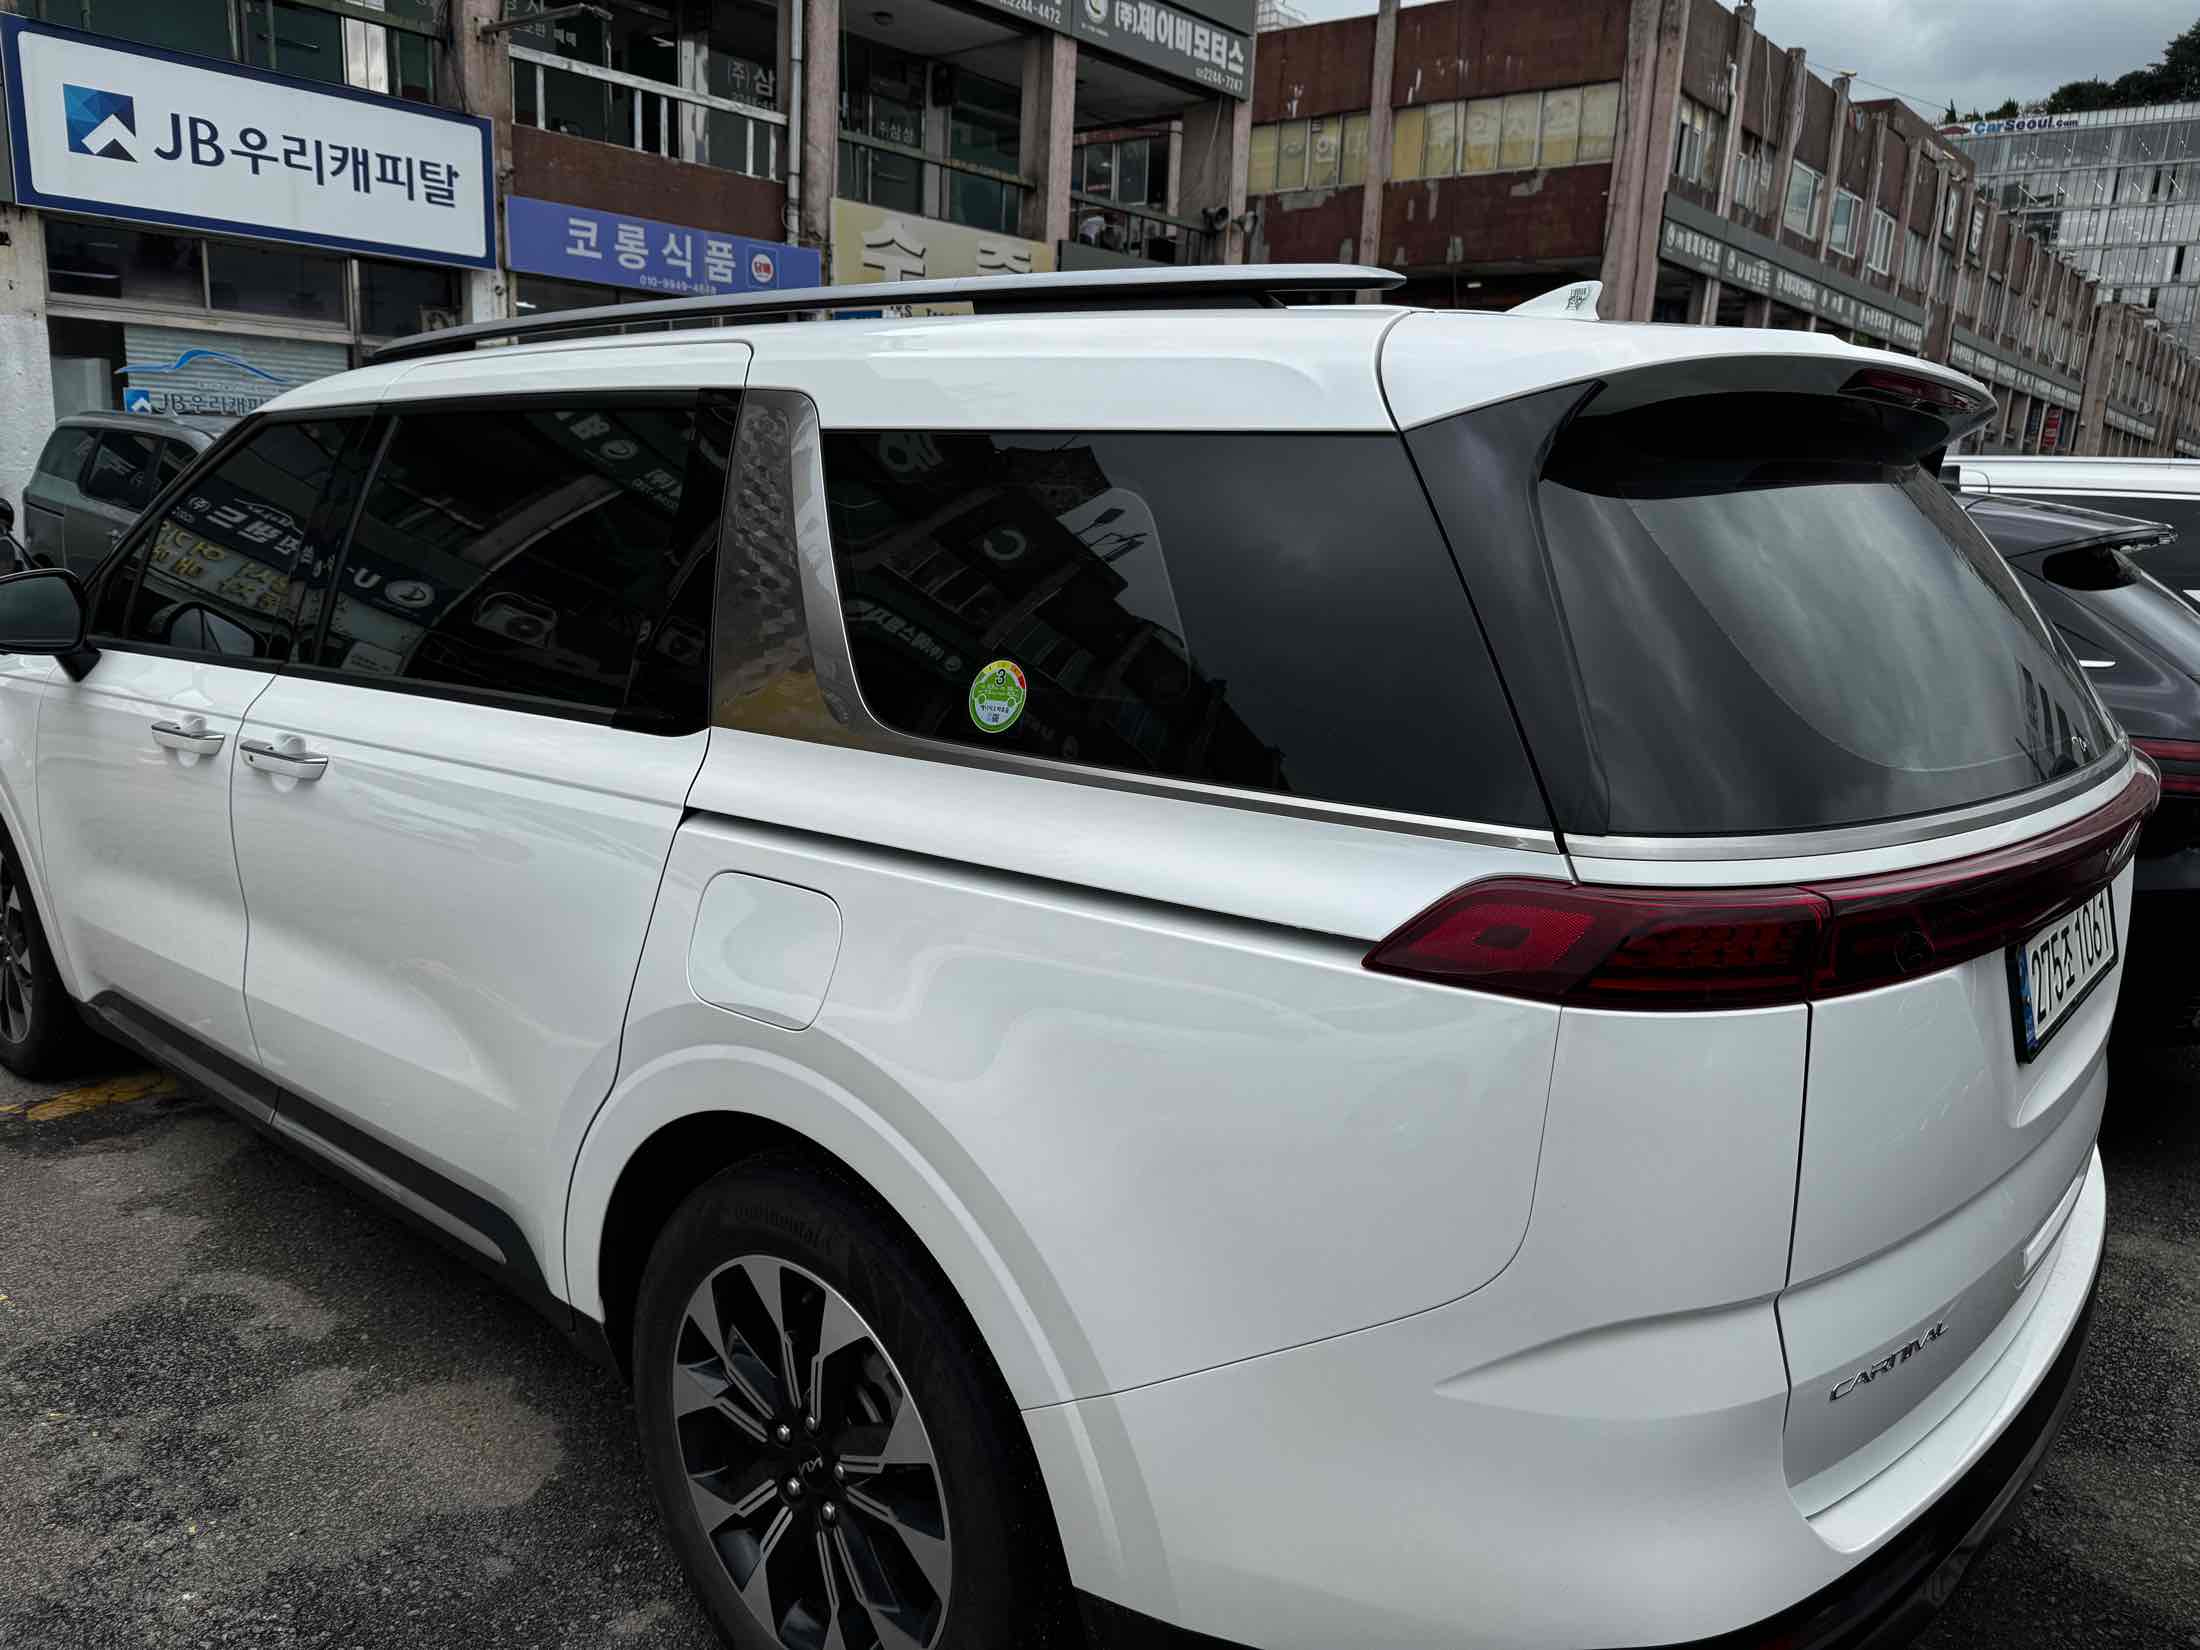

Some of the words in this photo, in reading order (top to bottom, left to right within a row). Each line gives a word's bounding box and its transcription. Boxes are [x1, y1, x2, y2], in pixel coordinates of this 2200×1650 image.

[1115, 1, 1245, 75] (주)제이비모터스
[154, 112, 461, 208] JB우리캐피탈
[566, 217, 737, 284] 코롱식품
[996, 669, 1005, 685] 3
